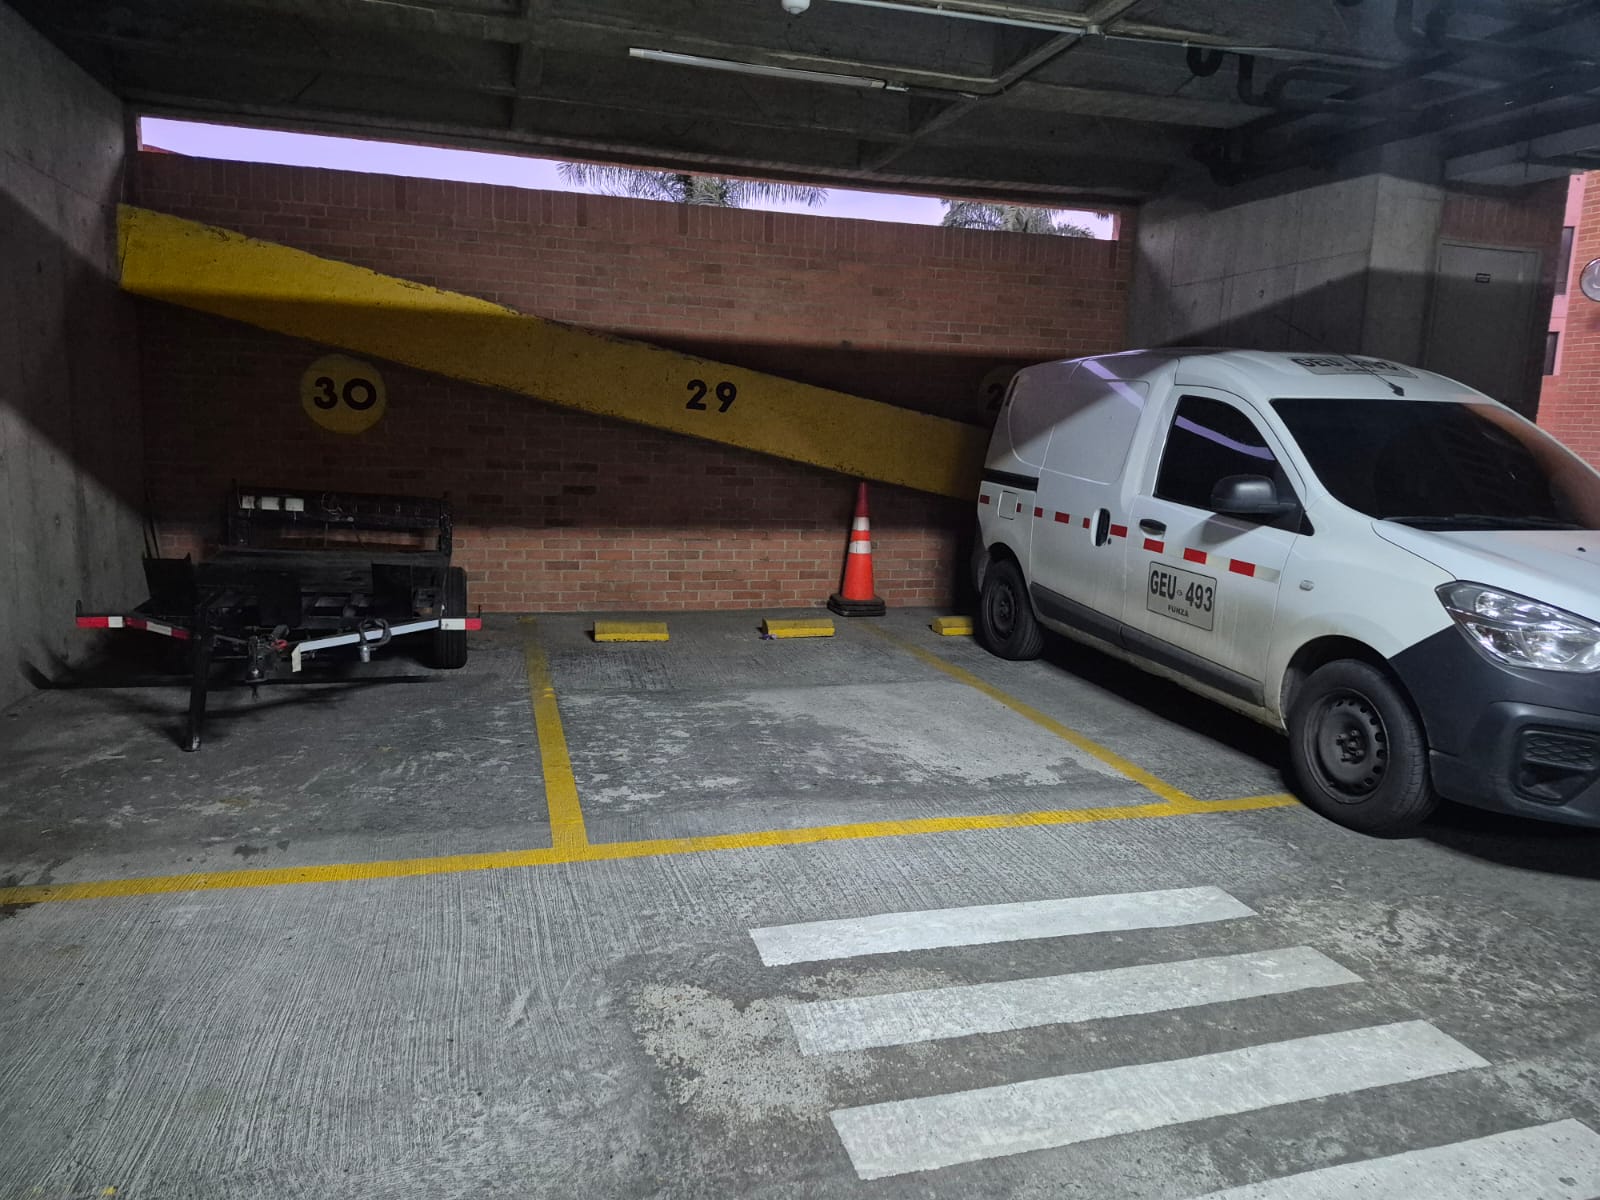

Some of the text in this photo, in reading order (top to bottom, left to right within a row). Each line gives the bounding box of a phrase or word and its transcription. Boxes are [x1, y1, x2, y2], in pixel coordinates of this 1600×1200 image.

[313, 376, 377, 411] 30
[686, 379, 737, 413] 29
[986, 383, 1006, 410] 2
[1150, 570, 1213, 612] GEU 493
